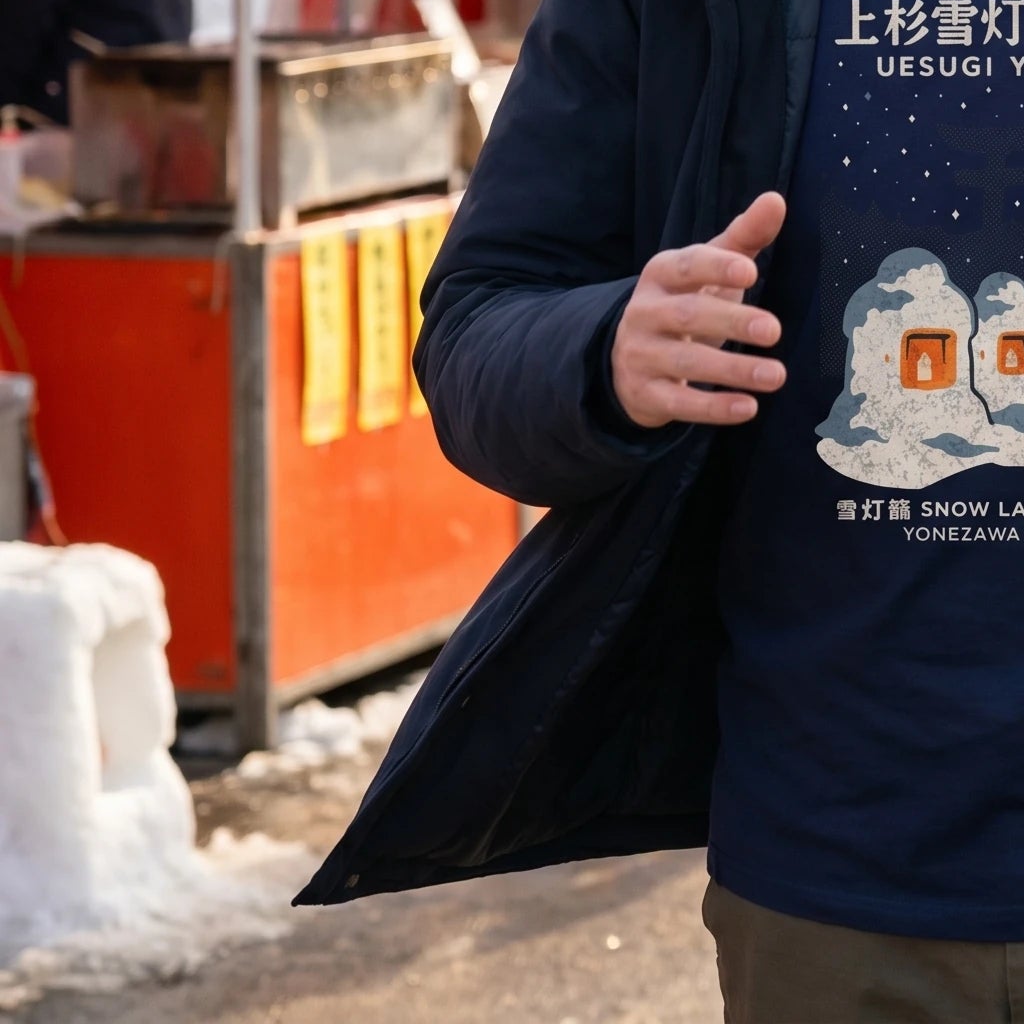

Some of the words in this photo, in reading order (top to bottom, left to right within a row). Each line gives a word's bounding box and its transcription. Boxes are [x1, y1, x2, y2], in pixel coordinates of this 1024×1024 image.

[876, 55, 992, 77] UESUGI
[921, 501, 990, 518] SNOW
[903, 526, 1020, 542] YONEZAWA
